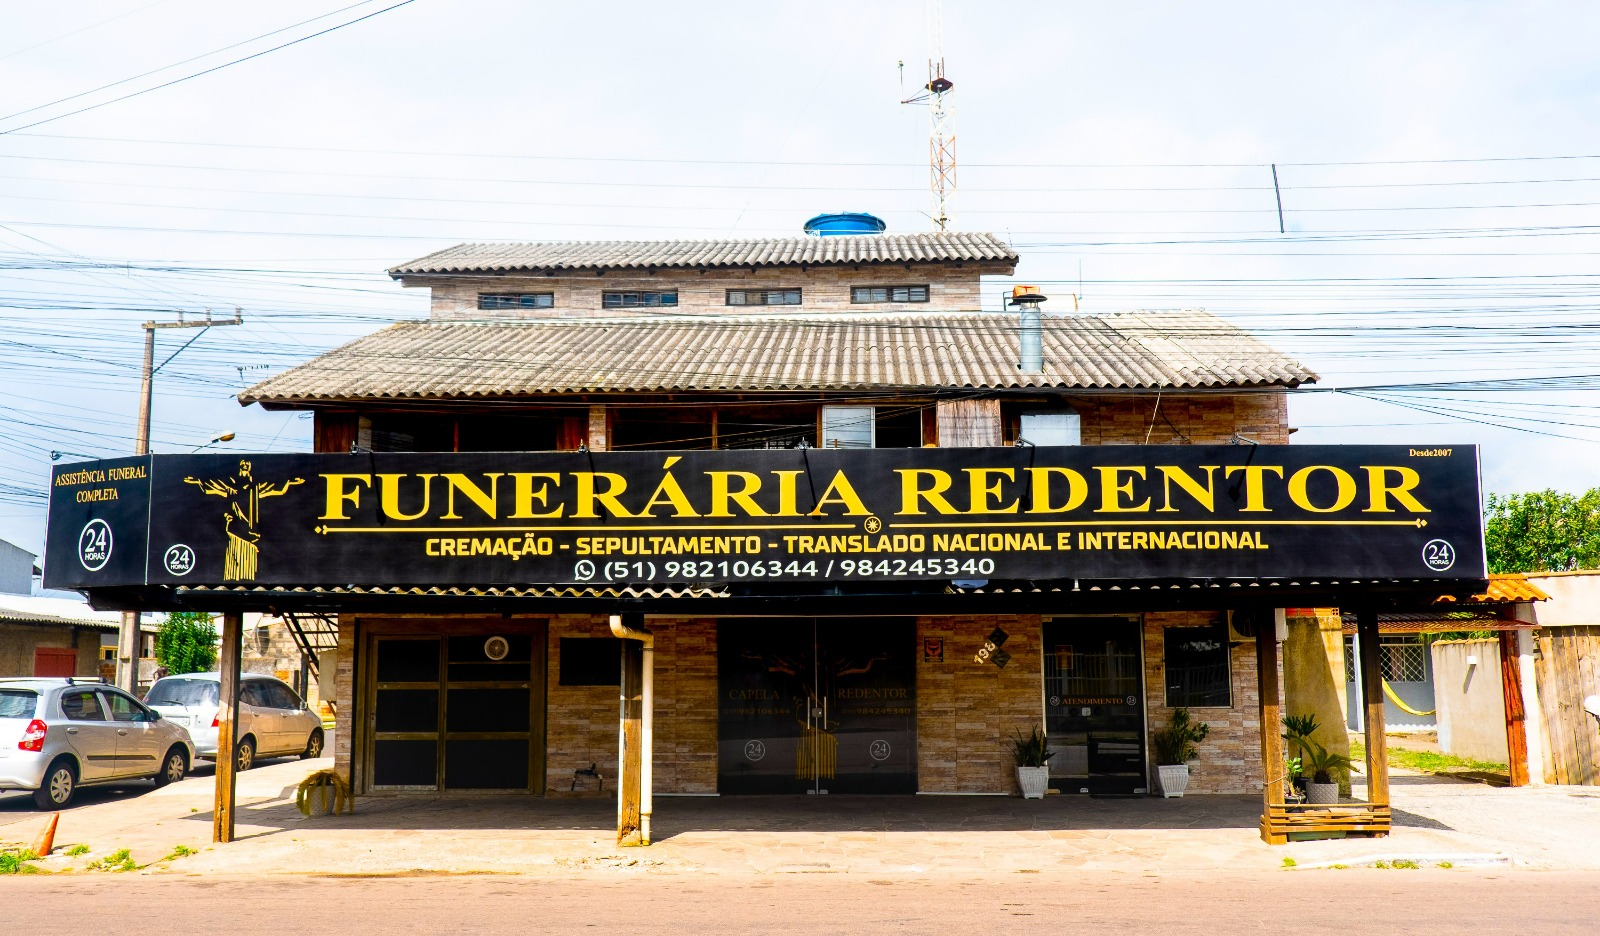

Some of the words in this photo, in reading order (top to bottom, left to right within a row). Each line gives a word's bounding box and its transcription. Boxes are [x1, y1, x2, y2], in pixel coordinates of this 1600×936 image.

[1409, 449, 1452, 457] Desde2007
[55, 469, 105, 486] ASSISTÊNCIA
[108, 466, 147, 481] FUNERAL
[317, 456, 873, 521] FUNERÁRIA
[893, 465, 1431, 514] REDENTOR
[76, 488, 119, 503] COMPLETA
[84, 526, 107, 553] 24
[425, 532, 553, 561] CREMAÇÃO
[576, 535, 761, 554] SEPULTAMENTO
[783, 534, 926, 555] TRANSLADO
[933, 532, 1052, 552] NACIONAL
[1058, 532, 1072, 551] E
[1078, 531, 1269, 551] INTERNACIONAL
[84, 553, 106, 562] HORAS
[170, 549, 190, 565] 24
[1428, 544, 1450, 560] 24
[170, 563, 190, 571] HORAS
[604, 560, 657, 581] (51)
[665, 560, 819, 579] 982106344
[824, 559, 836, 579] /
[841, 557, 995, 577] 984245340
[728, 689, 780, 700] CAPELA
[838, 688, 908, 699] REDENTOR
[1062, 697, 1123, 705] ATENDIMENTO
[748, 743, 761, 754] 24
[873, 743, 887, 753] 24
